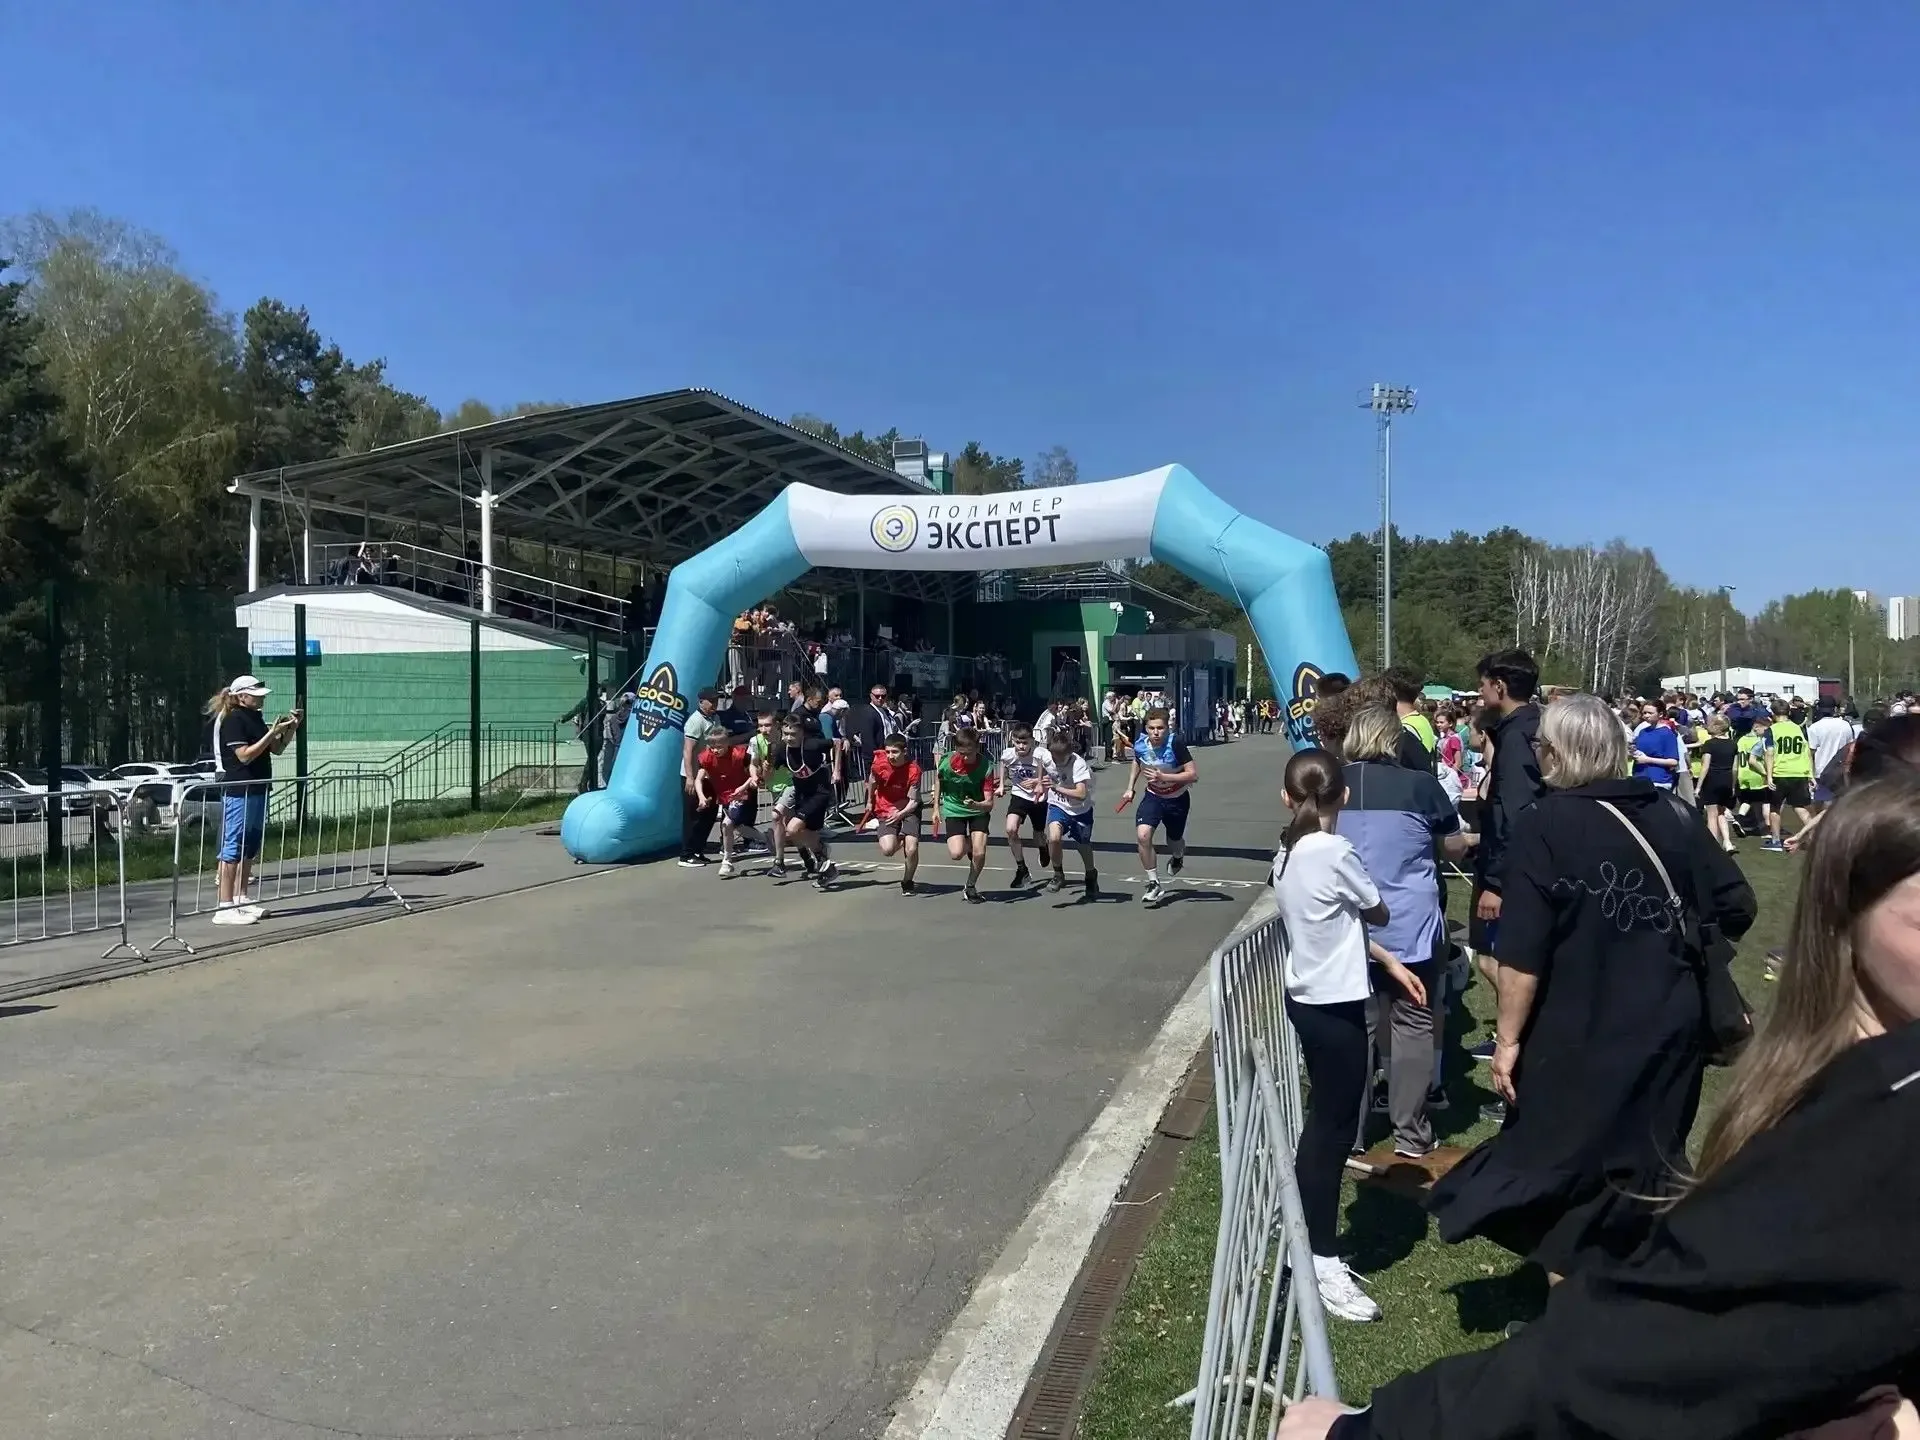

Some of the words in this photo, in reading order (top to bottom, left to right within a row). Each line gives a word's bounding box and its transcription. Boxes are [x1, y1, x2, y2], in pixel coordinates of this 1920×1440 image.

[928, 496, 1063, 519] ПОЛИМЕР
[927, 514, 1061, 550] ЭКСПЕРТ
[638, 686, 685, 711] GOOD
[1776, 735, 1803, 755] 106
